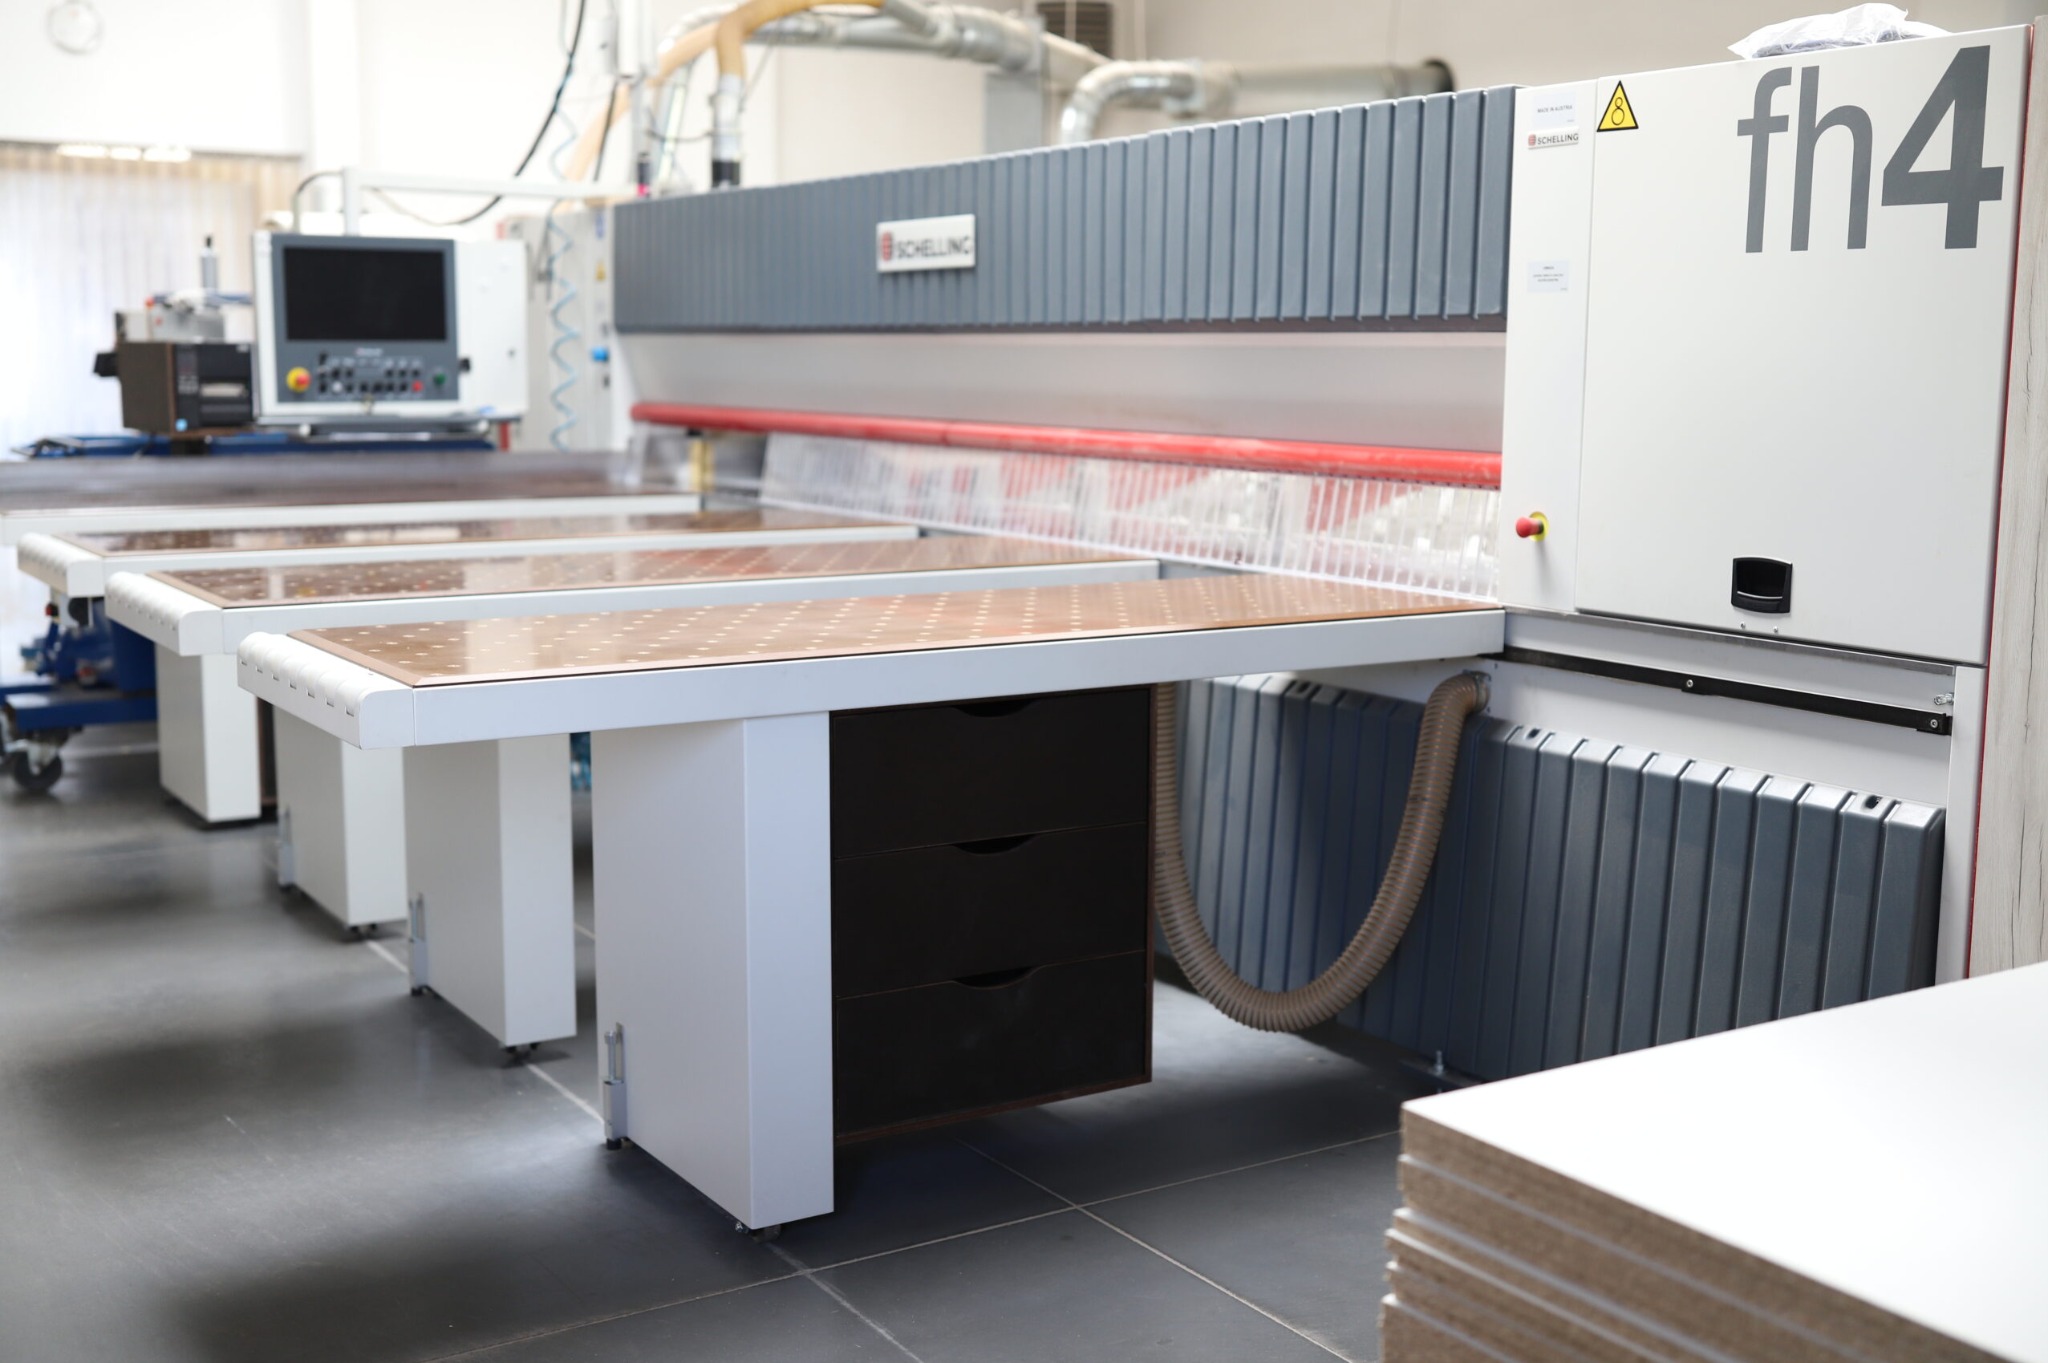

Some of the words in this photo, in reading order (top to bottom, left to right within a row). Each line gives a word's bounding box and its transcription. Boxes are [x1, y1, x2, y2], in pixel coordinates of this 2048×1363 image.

[1537, 133, 1579, 145] SCHELLING
[1737, 45, 2004, 253] fh4
[896, 236, 973, 258] SCHELLING
